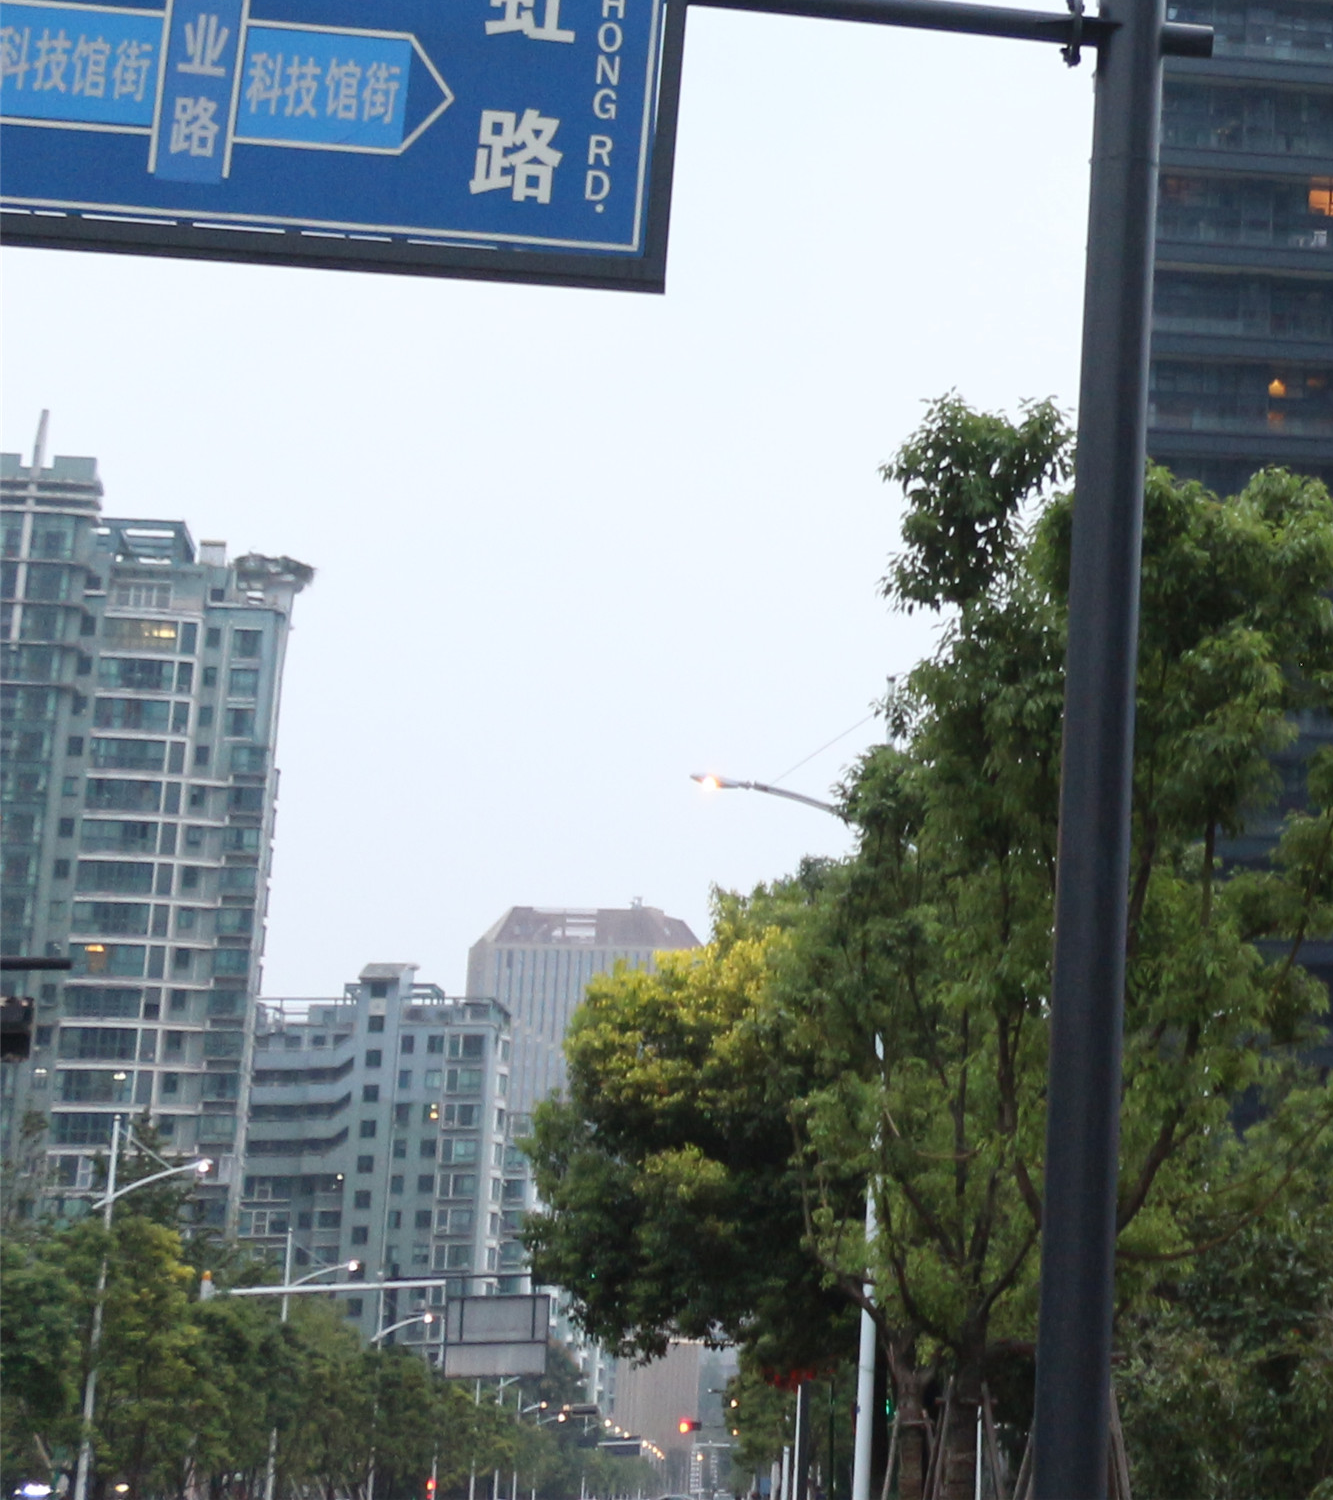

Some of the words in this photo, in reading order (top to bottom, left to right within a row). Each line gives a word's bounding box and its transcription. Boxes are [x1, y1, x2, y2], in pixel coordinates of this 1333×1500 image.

[0, 26, 153, 102] 科技馆街
[245, 52, 401, 124] 科技馆街
[584, 134, 615, 214] RD.
